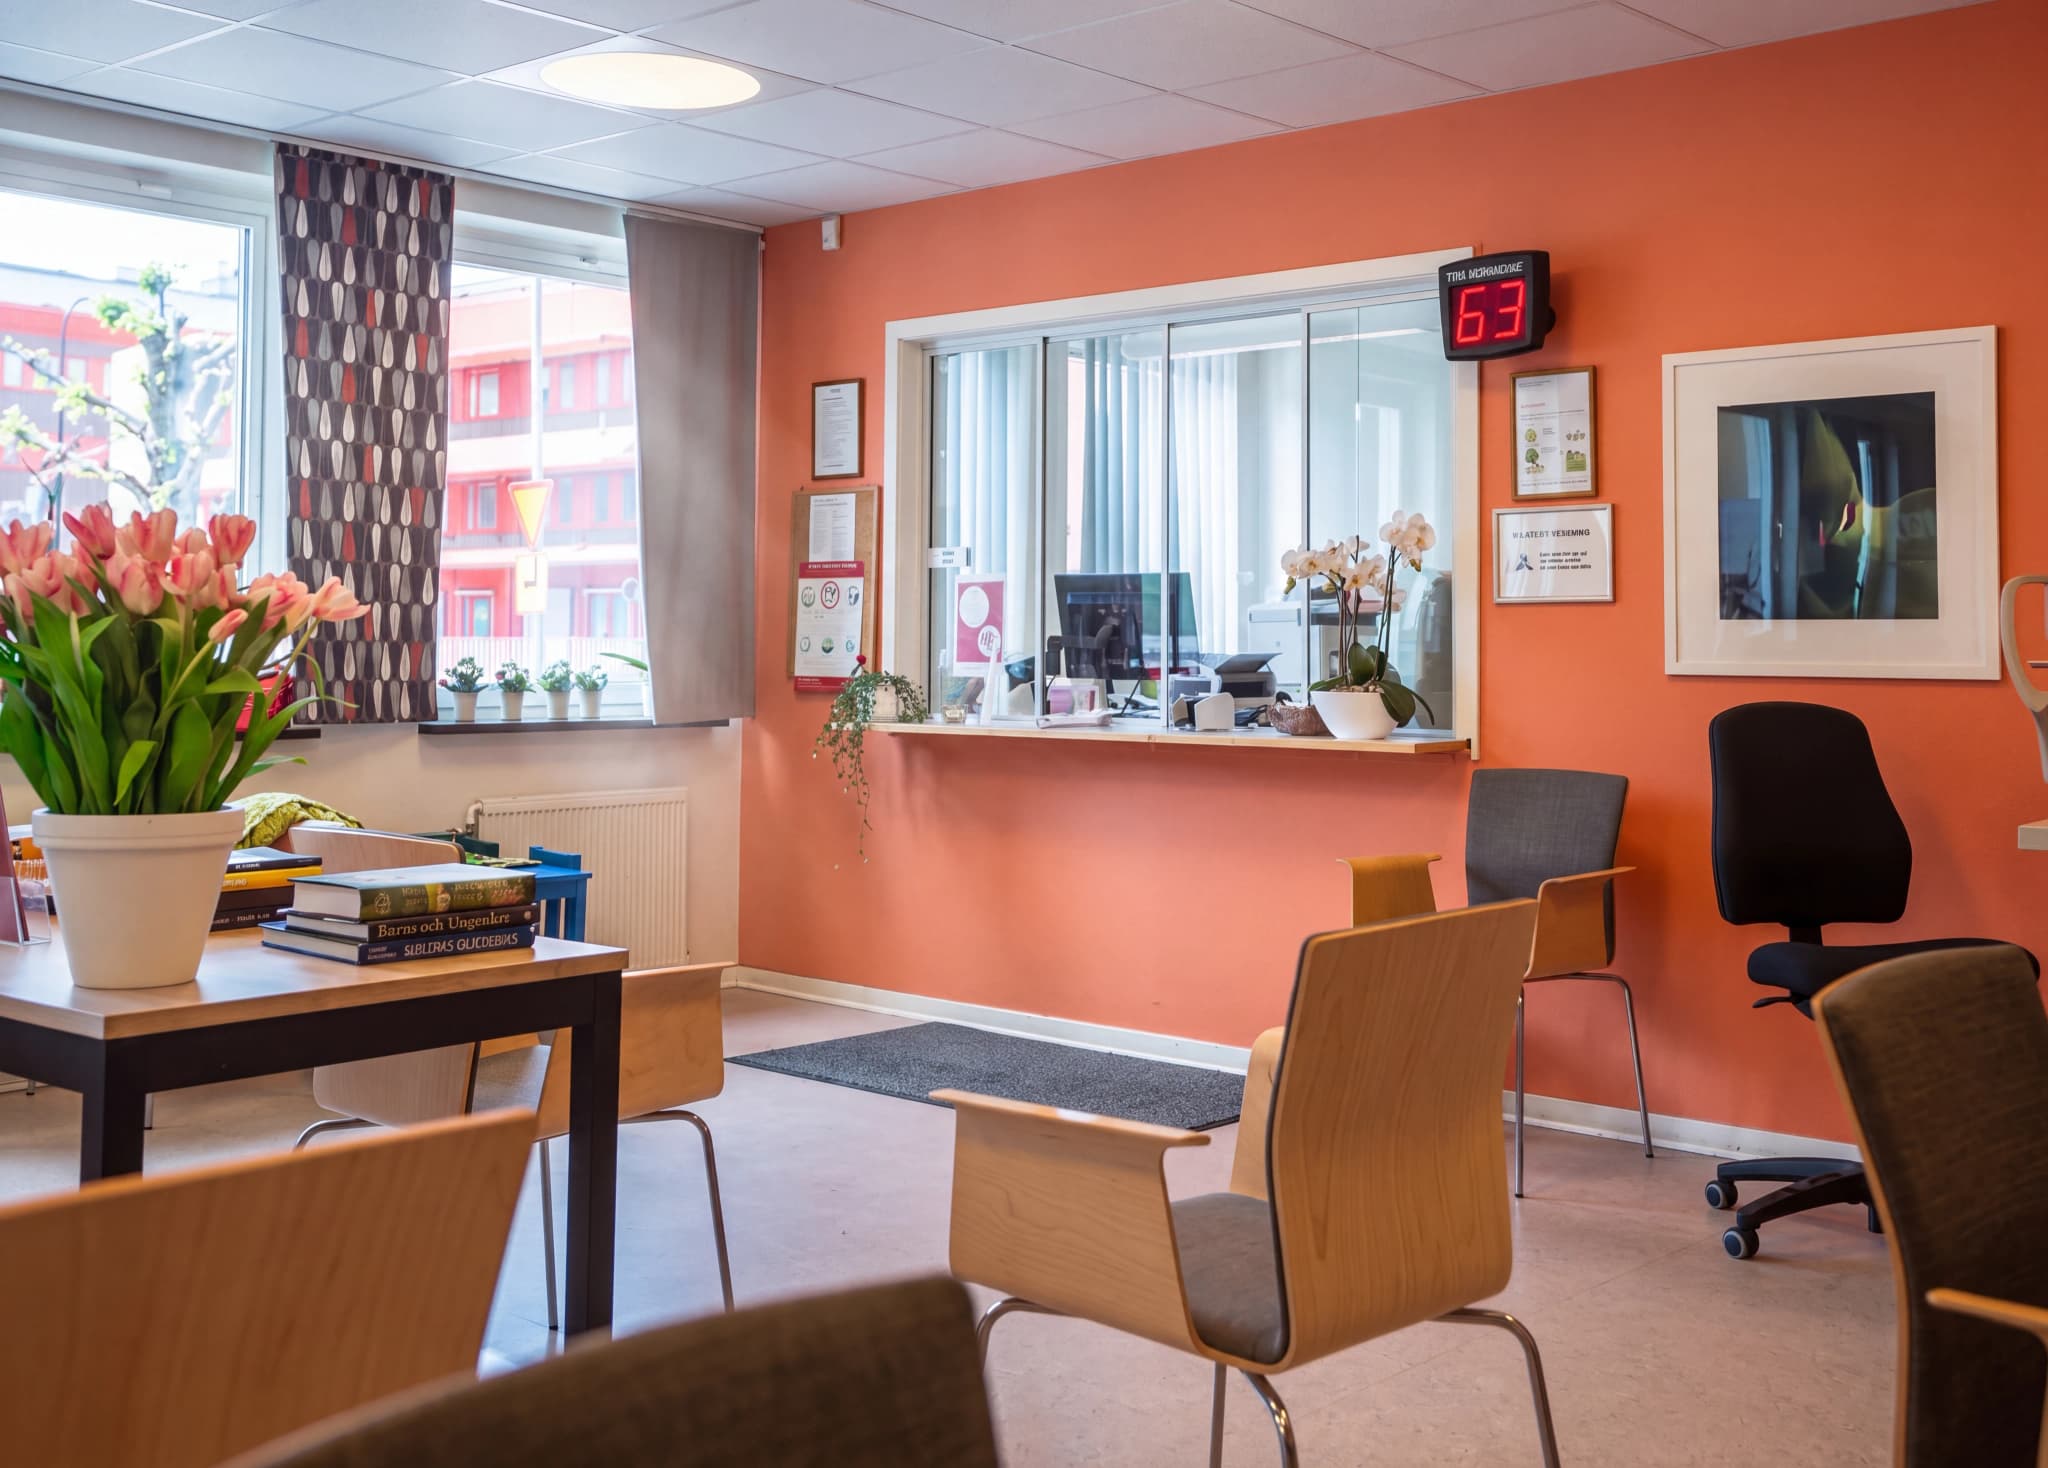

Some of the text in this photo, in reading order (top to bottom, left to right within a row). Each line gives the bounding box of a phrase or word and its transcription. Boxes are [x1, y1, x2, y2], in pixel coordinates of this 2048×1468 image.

[1456, 279, 1525, 344] 63
[378, 924, 417, 938] Barns
[420, 918, 444, 933] och
